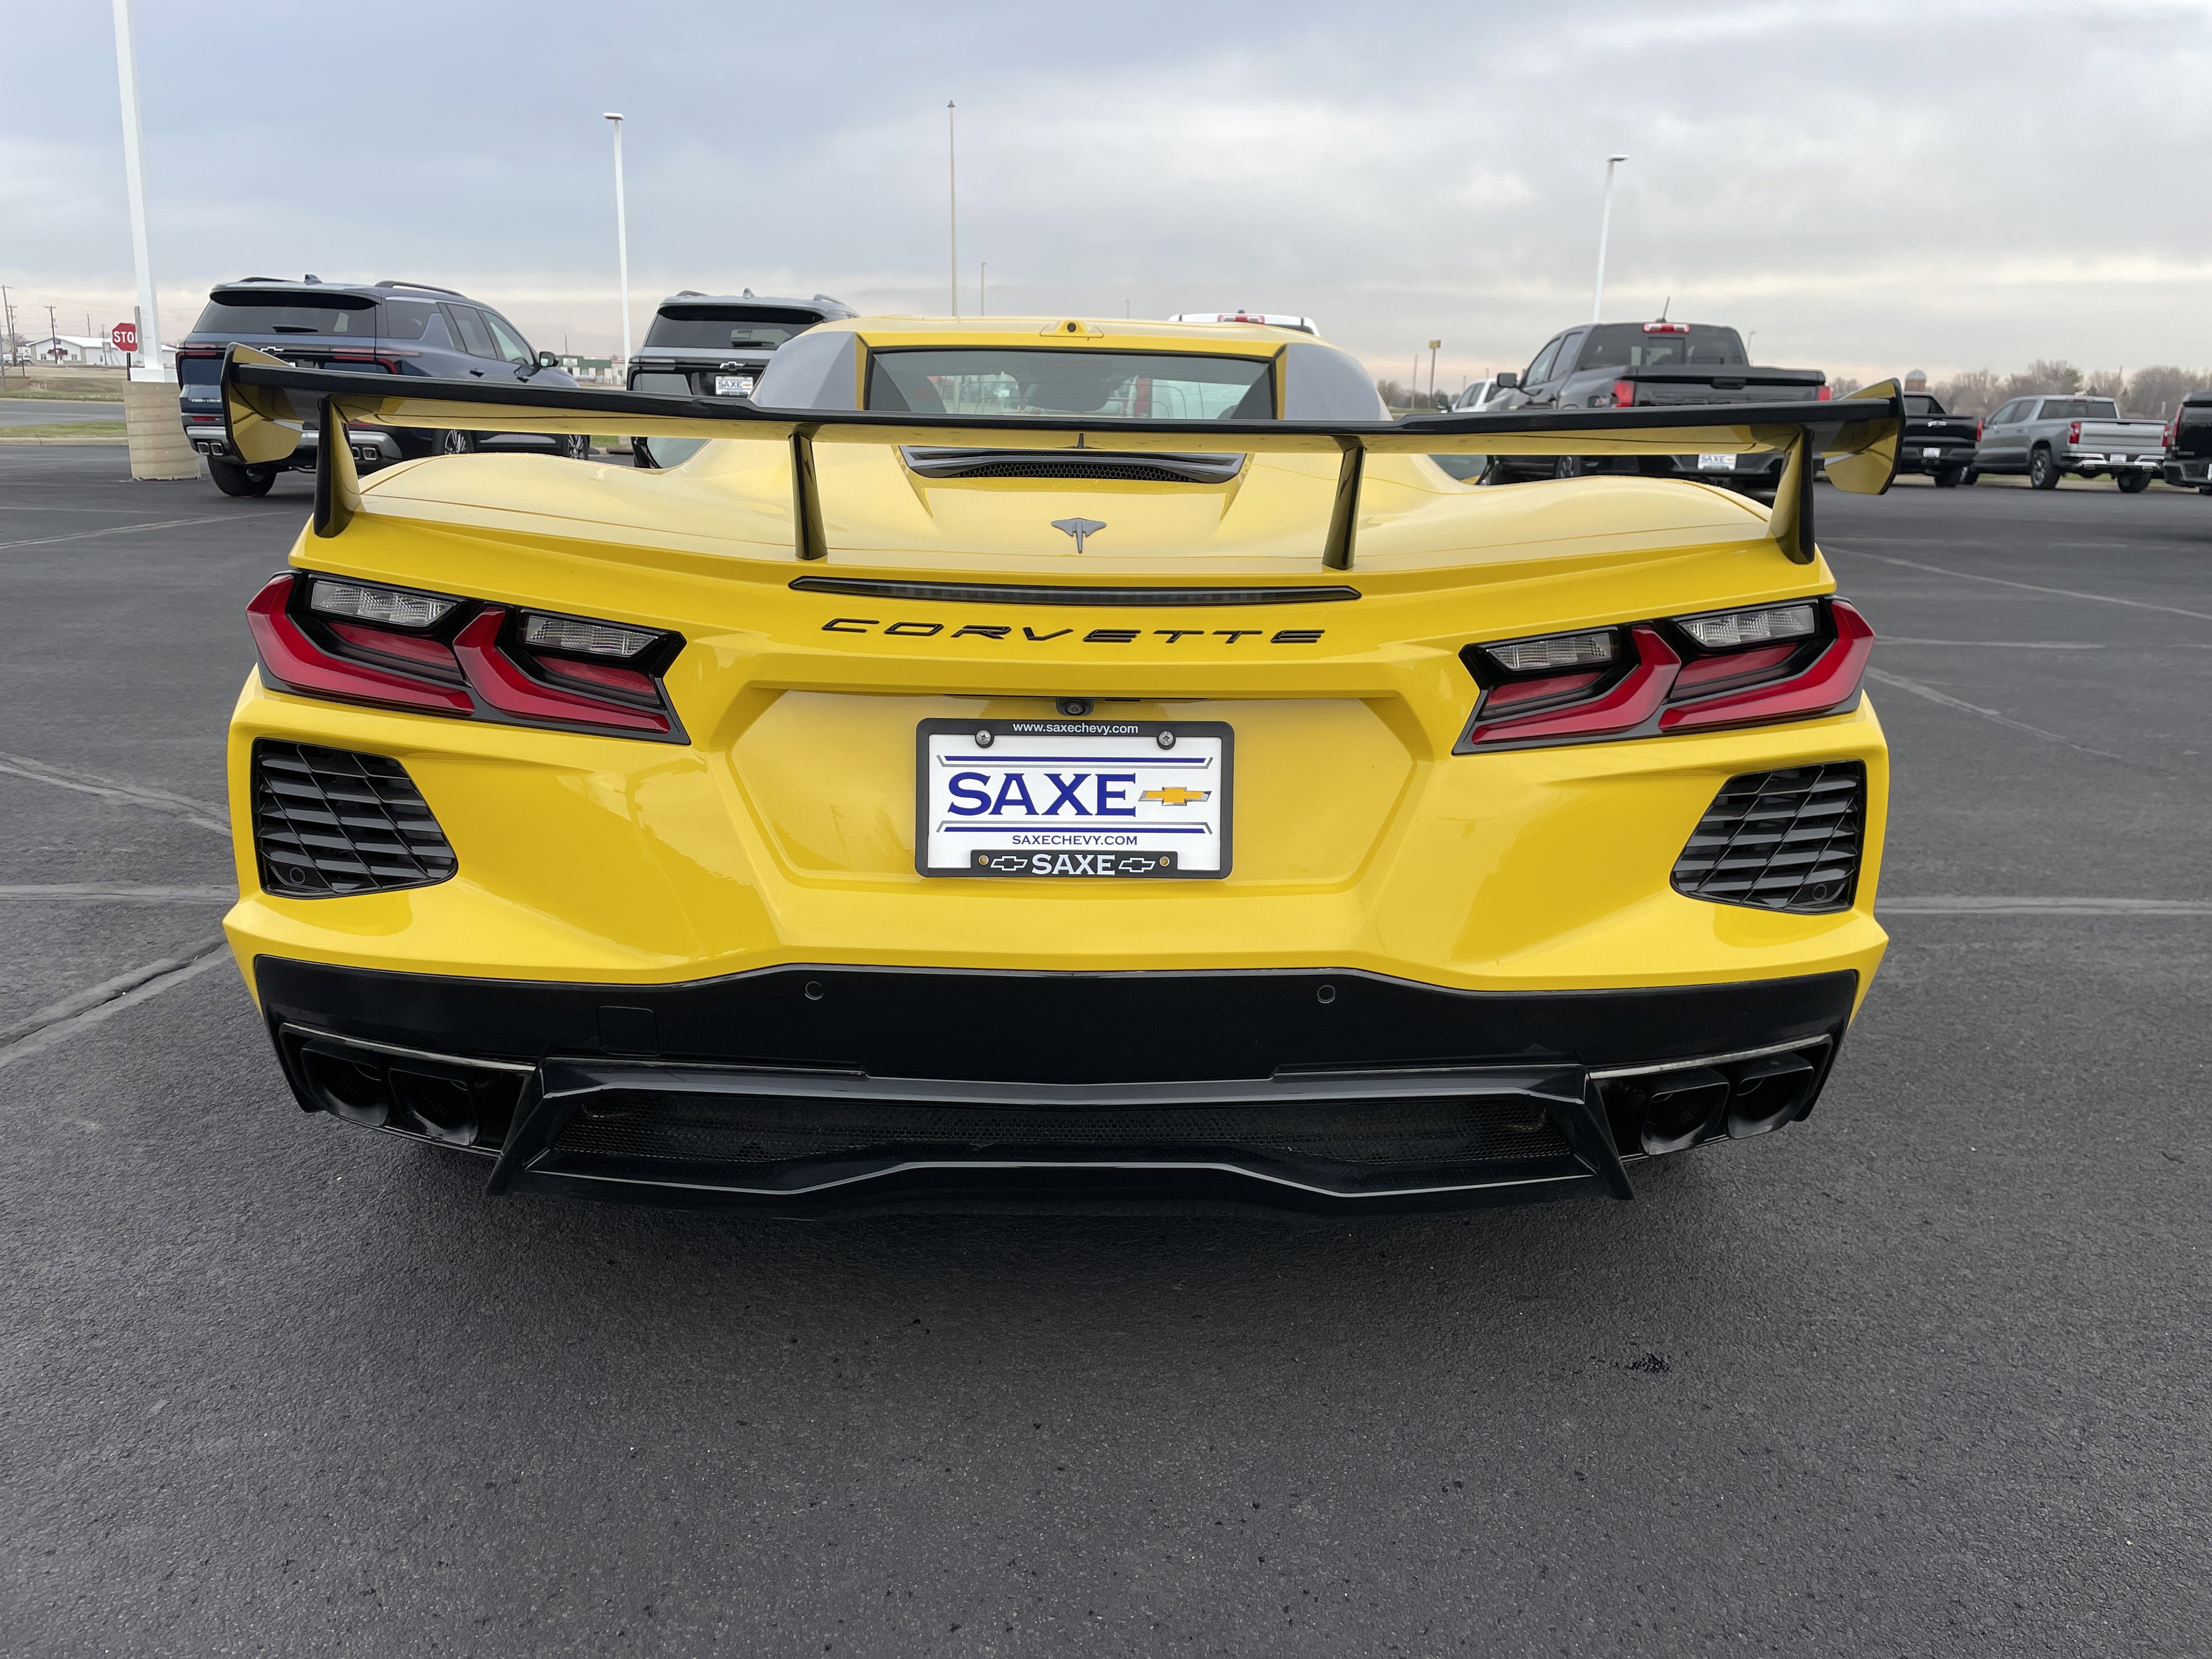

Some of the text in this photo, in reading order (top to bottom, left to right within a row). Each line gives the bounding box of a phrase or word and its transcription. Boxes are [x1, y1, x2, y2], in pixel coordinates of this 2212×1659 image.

[821, 618, 1326, 645] CORVETTE
[1013, 723, 1138, 736] www.saxechevy.com
[947, 771, 1136, 817] SAXE
[1012, 835, 1138, 845] SAXECHEVY.COM
[1031, 854, 1115, 876] SAXE
